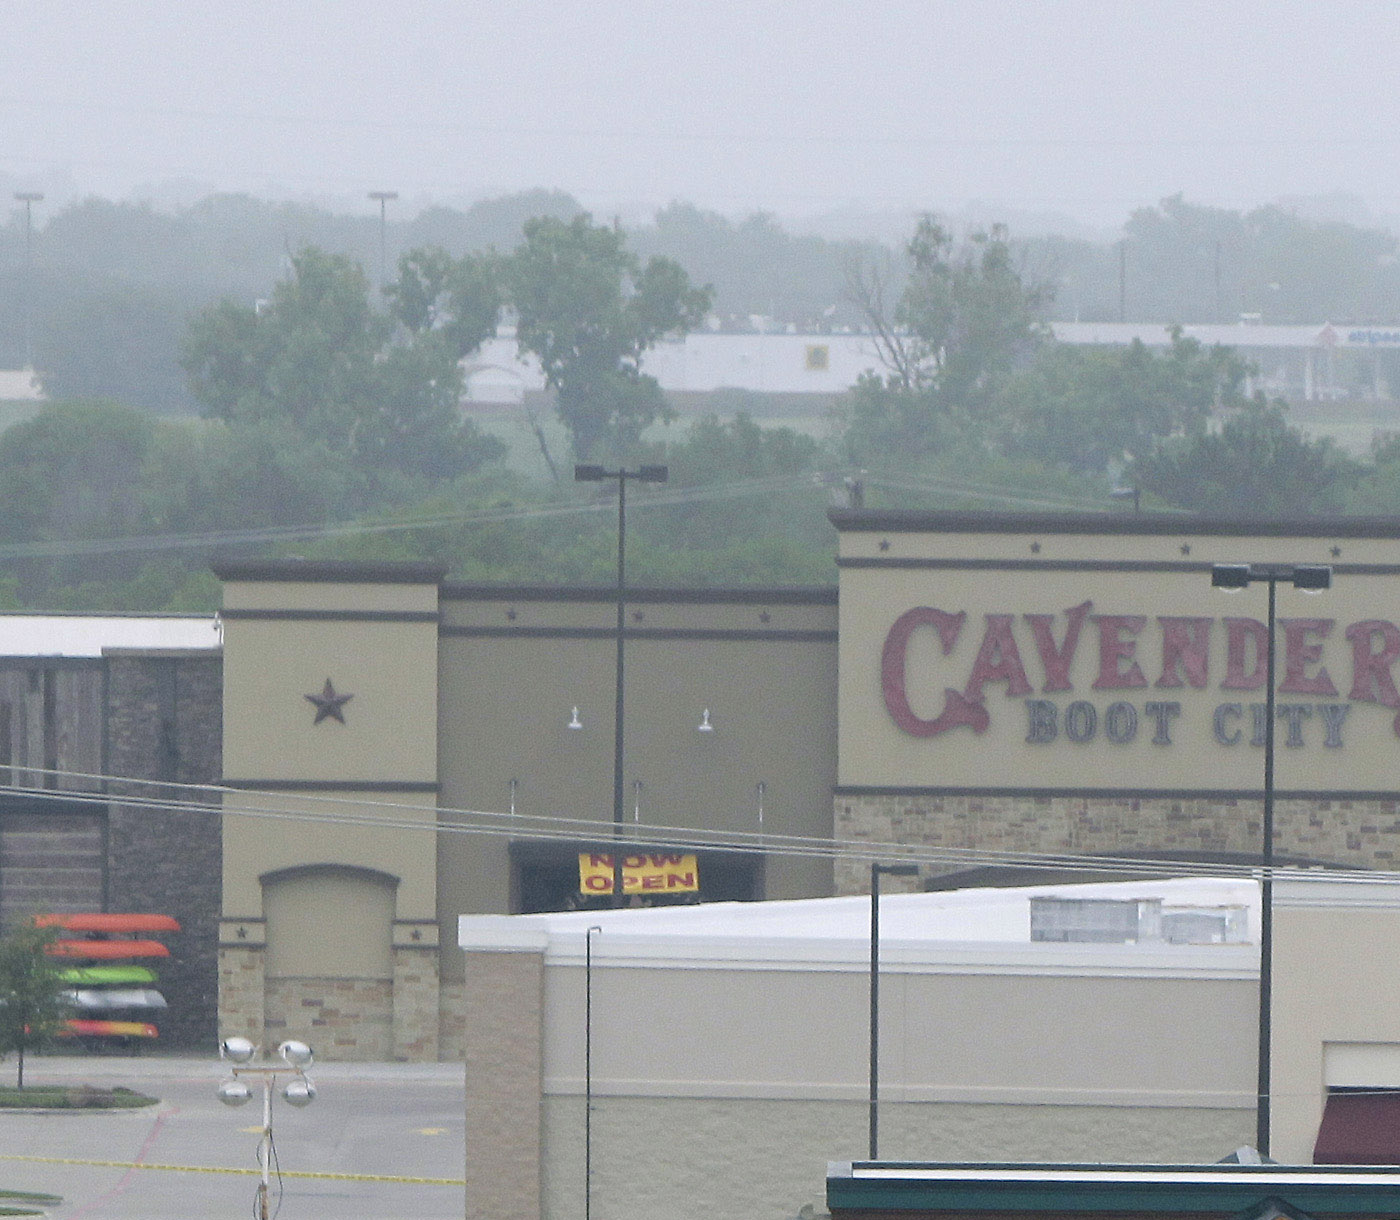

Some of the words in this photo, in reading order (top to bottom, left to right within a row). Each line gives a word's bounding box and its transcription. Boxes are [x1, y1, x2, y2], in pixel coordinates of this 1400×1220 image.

[1024, 699, 1182, 745] BOOT
[1213, 702, 1352, 749] CITY
[586, 873, 693, 890] OPEN
